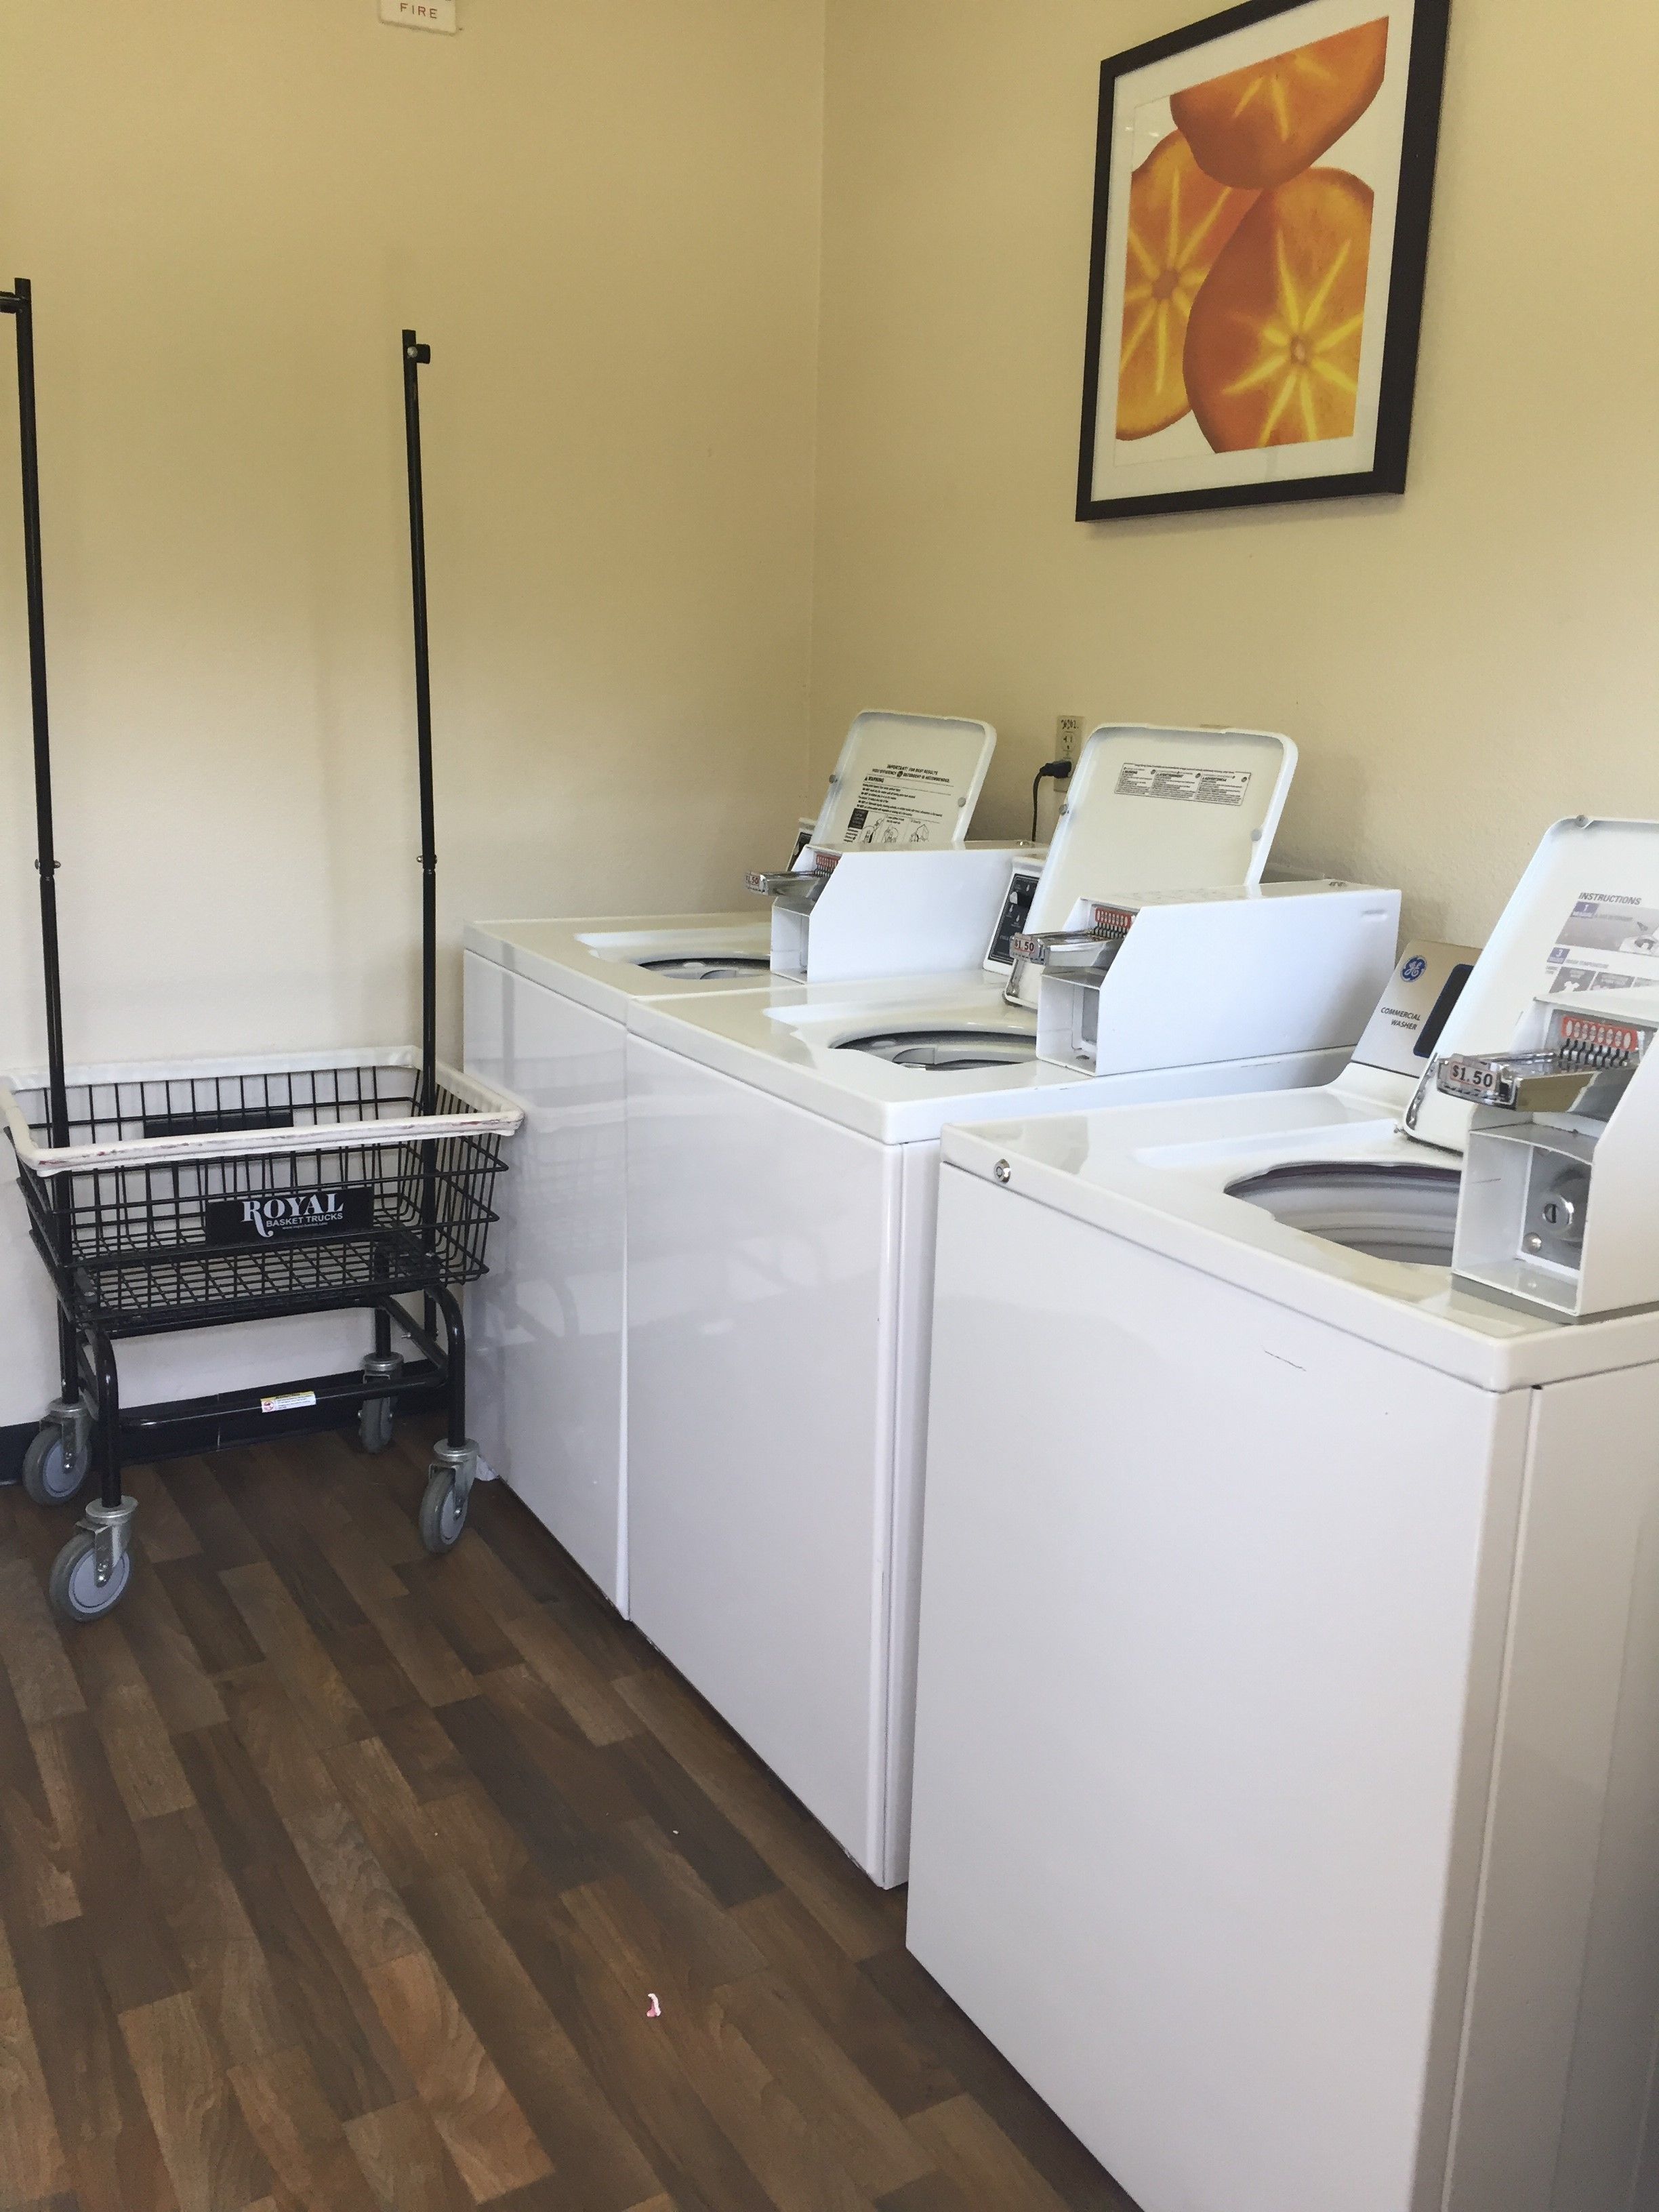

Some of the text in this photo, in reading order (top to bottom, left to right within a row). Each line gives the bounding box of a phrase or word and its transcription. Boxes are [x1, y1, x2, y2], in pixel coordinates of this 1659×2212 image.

[400, 3, 437, 18] FIRE
[1578, 892, 1641, 905] INSTRUCTIONS
[1380, 1007, 1420, 1021] COMMERCIAL
[1391, 1019, 1418, 1030] WASHER
[1452, 1065, 1493, 1088] $1.50
[241, 1193, 344, 1237] ROYAL
[266, 1212, 343, 1227] BASKET TRUCKS
